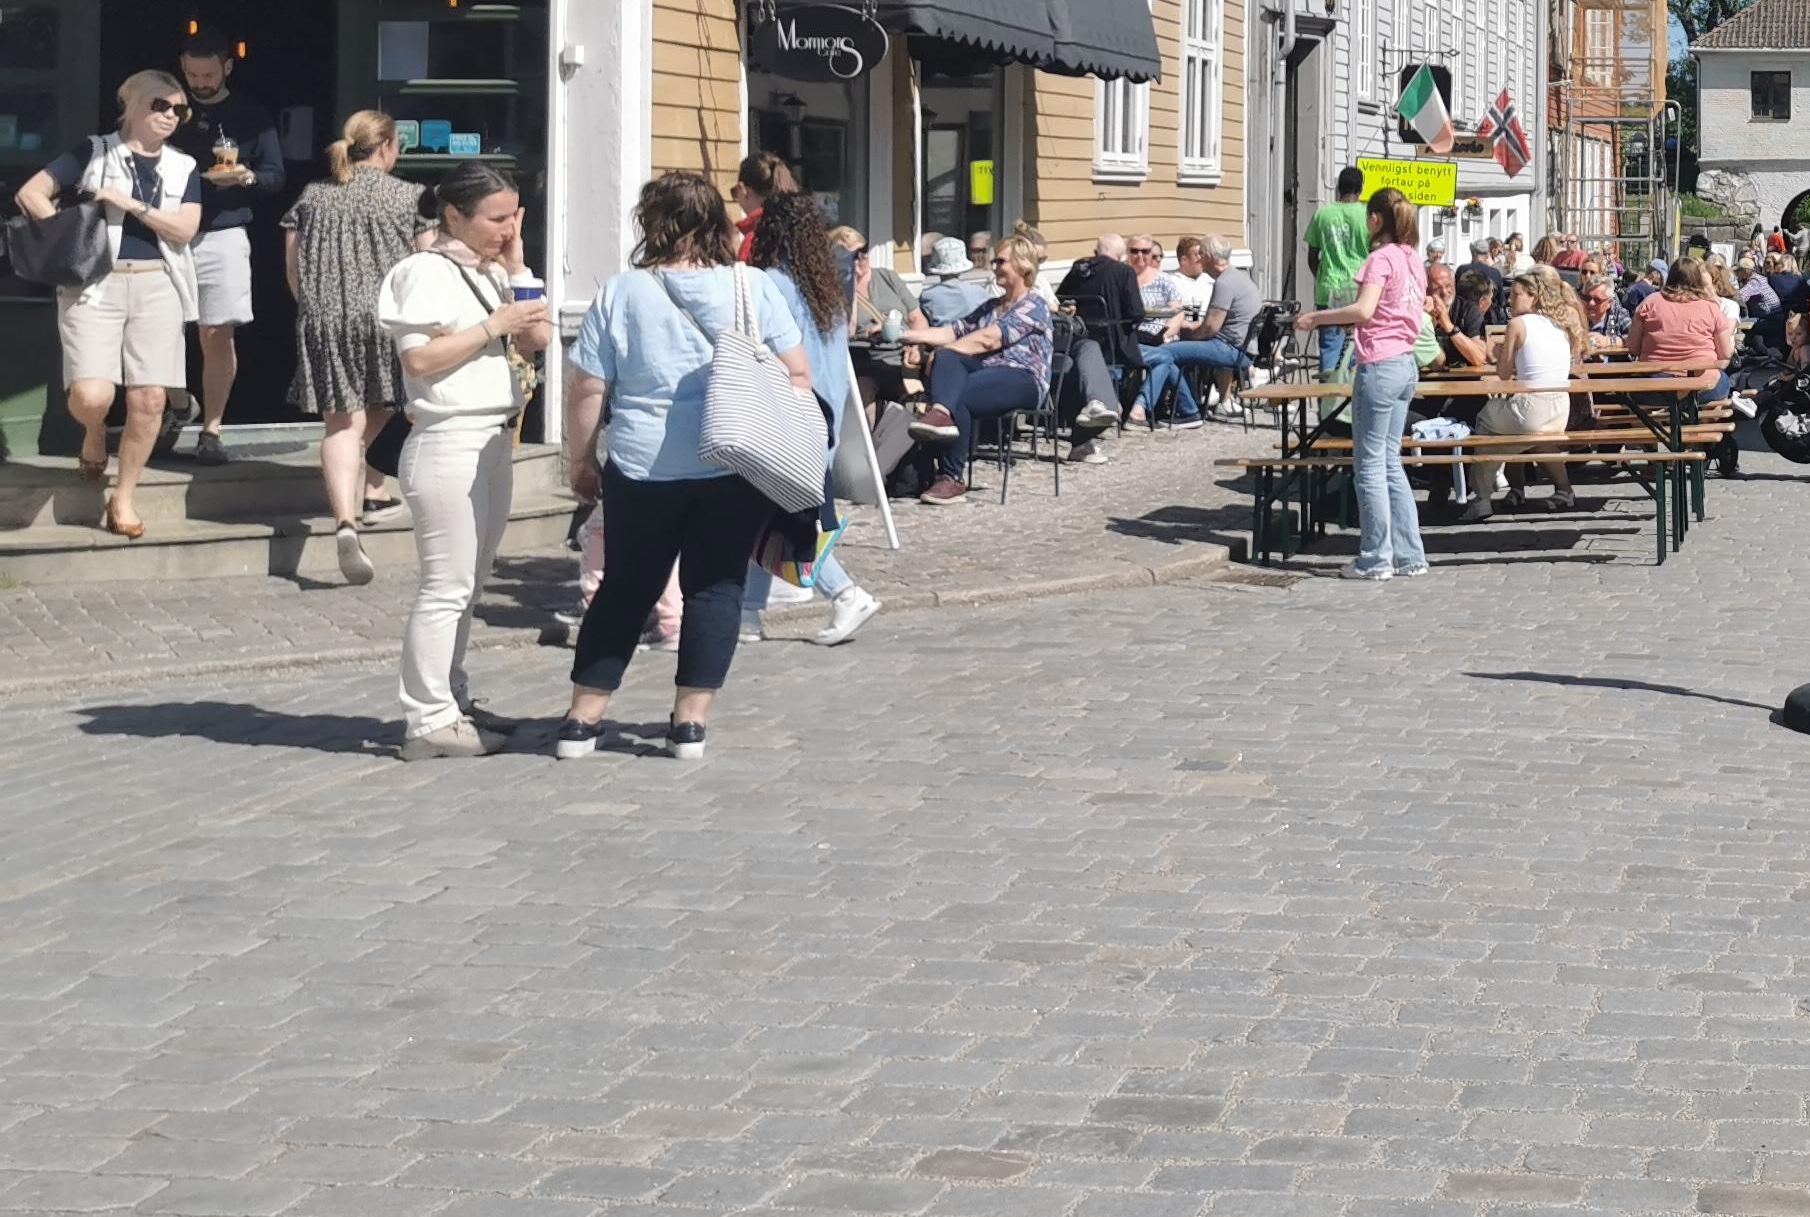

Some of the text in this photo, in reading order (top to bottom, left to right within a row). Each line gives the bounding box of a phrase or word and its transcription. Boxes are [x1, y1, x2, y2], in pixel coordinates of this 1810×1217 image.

[777, 17, 864, 79] Mormors
[1362, 161, 1452, 178] Vennligst benytt
[1380, 176, 1431, 189] fortau på
[1408, 190, 1437, 201] siden
